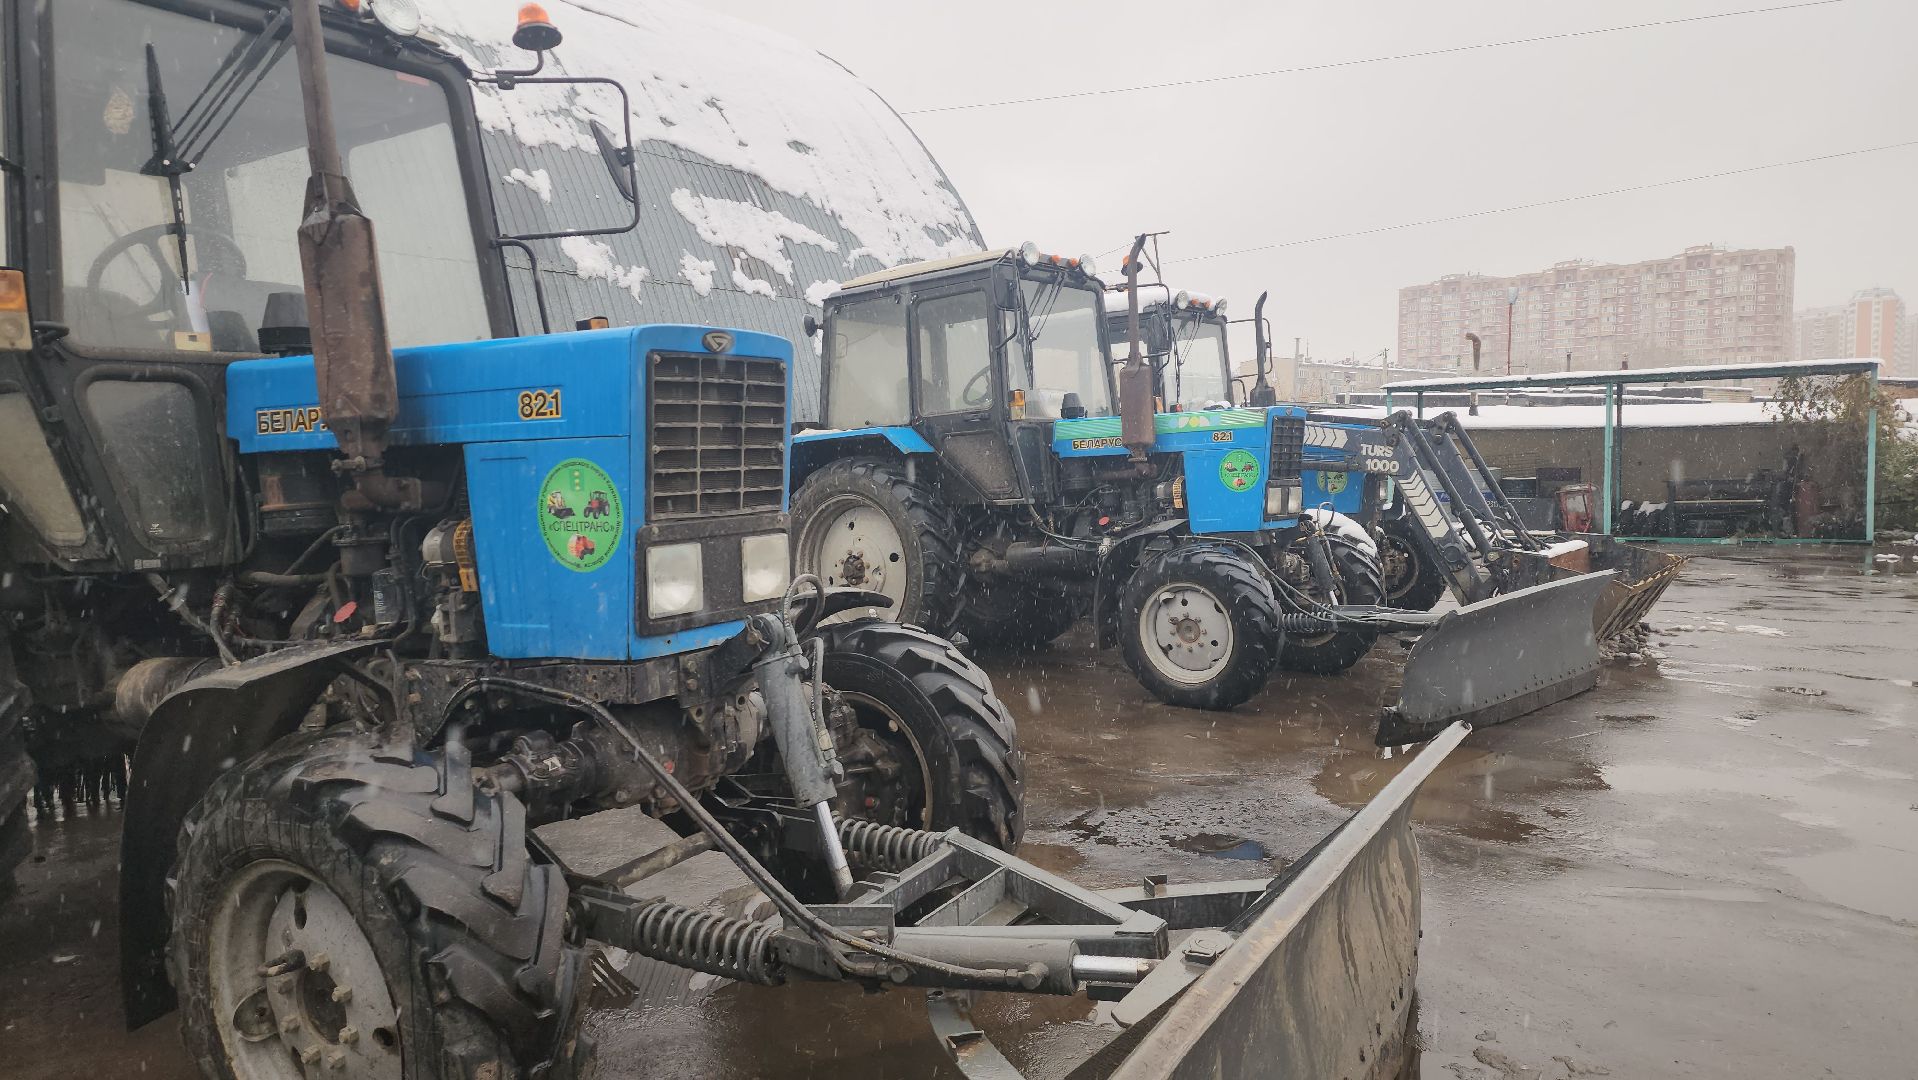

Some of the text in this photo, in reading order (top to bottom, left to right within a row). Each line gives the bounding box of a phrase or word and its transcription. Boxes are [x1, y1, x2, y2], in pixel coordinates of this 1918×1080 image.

[518, 390, 561, 419] 82.1
[256, 406, 329, 435] БЕЛАР
[1072, 437, 1122, 450] БЕЛАРУС
[1361, 444, 1393, 457] TURS
[1366, 459, 1399, 473] 1000
